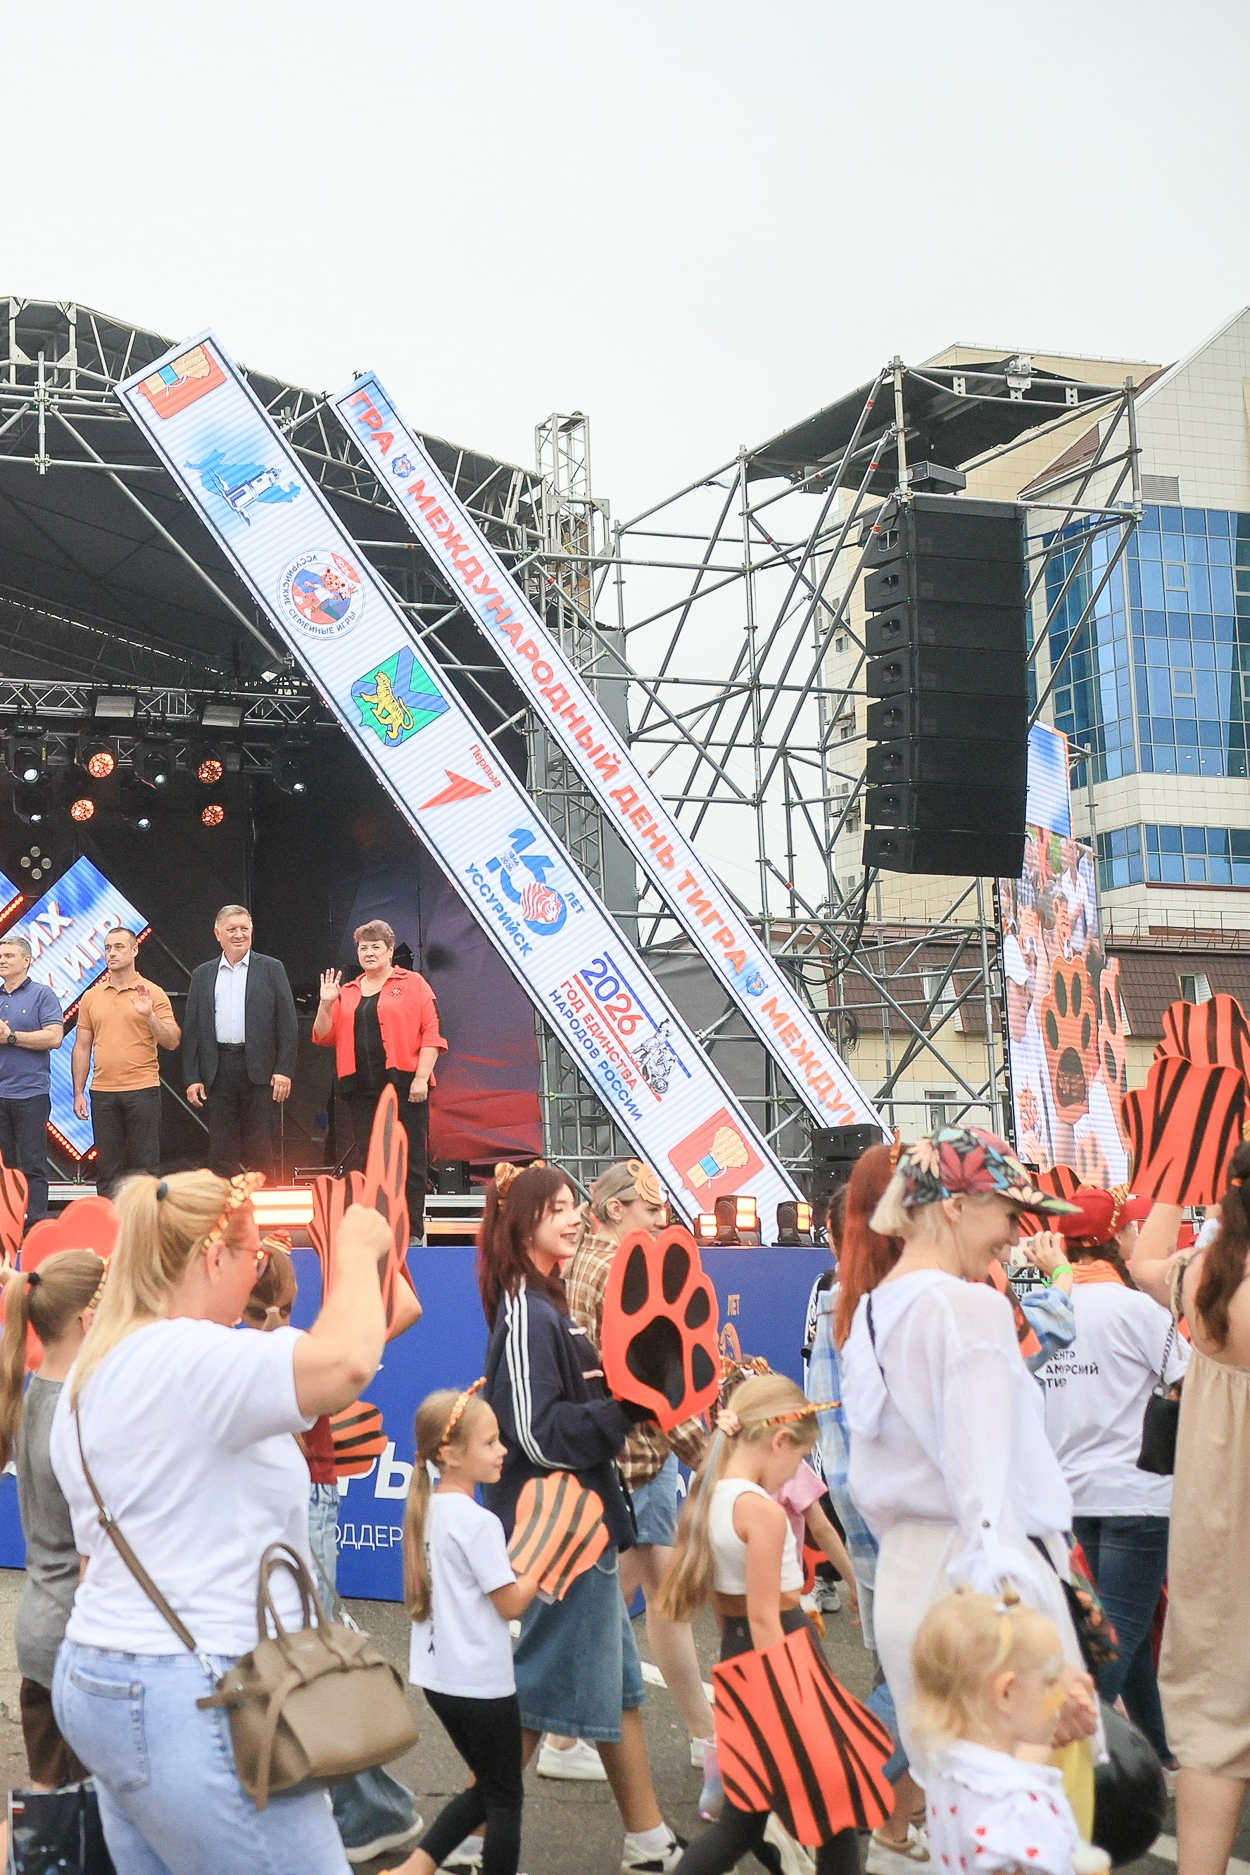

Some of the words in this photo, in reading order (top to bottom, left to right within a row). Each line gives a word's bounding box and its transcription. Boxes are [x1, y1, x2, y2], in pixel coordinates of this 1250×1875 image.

[336, 611, 357, 632] ИГРЫ
[348, 390, 395, 456] ГРА
[407, 479, 622, 781] МЕЖДУНАРОДНЫЙ
[609, 784, 675, 870] ДЕНЬ
[677, 869, 748, 975] ТИГРА
[470, 744, 501, 788] Первые
[465, 863, 533, 957] УССУРИЙСК
[565, 891, 585, 915] ЛЕТ
[560, 980, 585, 1013] ГОД
[582, 1012, 638, 1091] ЕДИНСТВА
[579, 958, 643, 1035] 2026
[549, 990, 600, 1059] НАРОДОВ
[597, 1060, 643, 1122] РОССИИ
